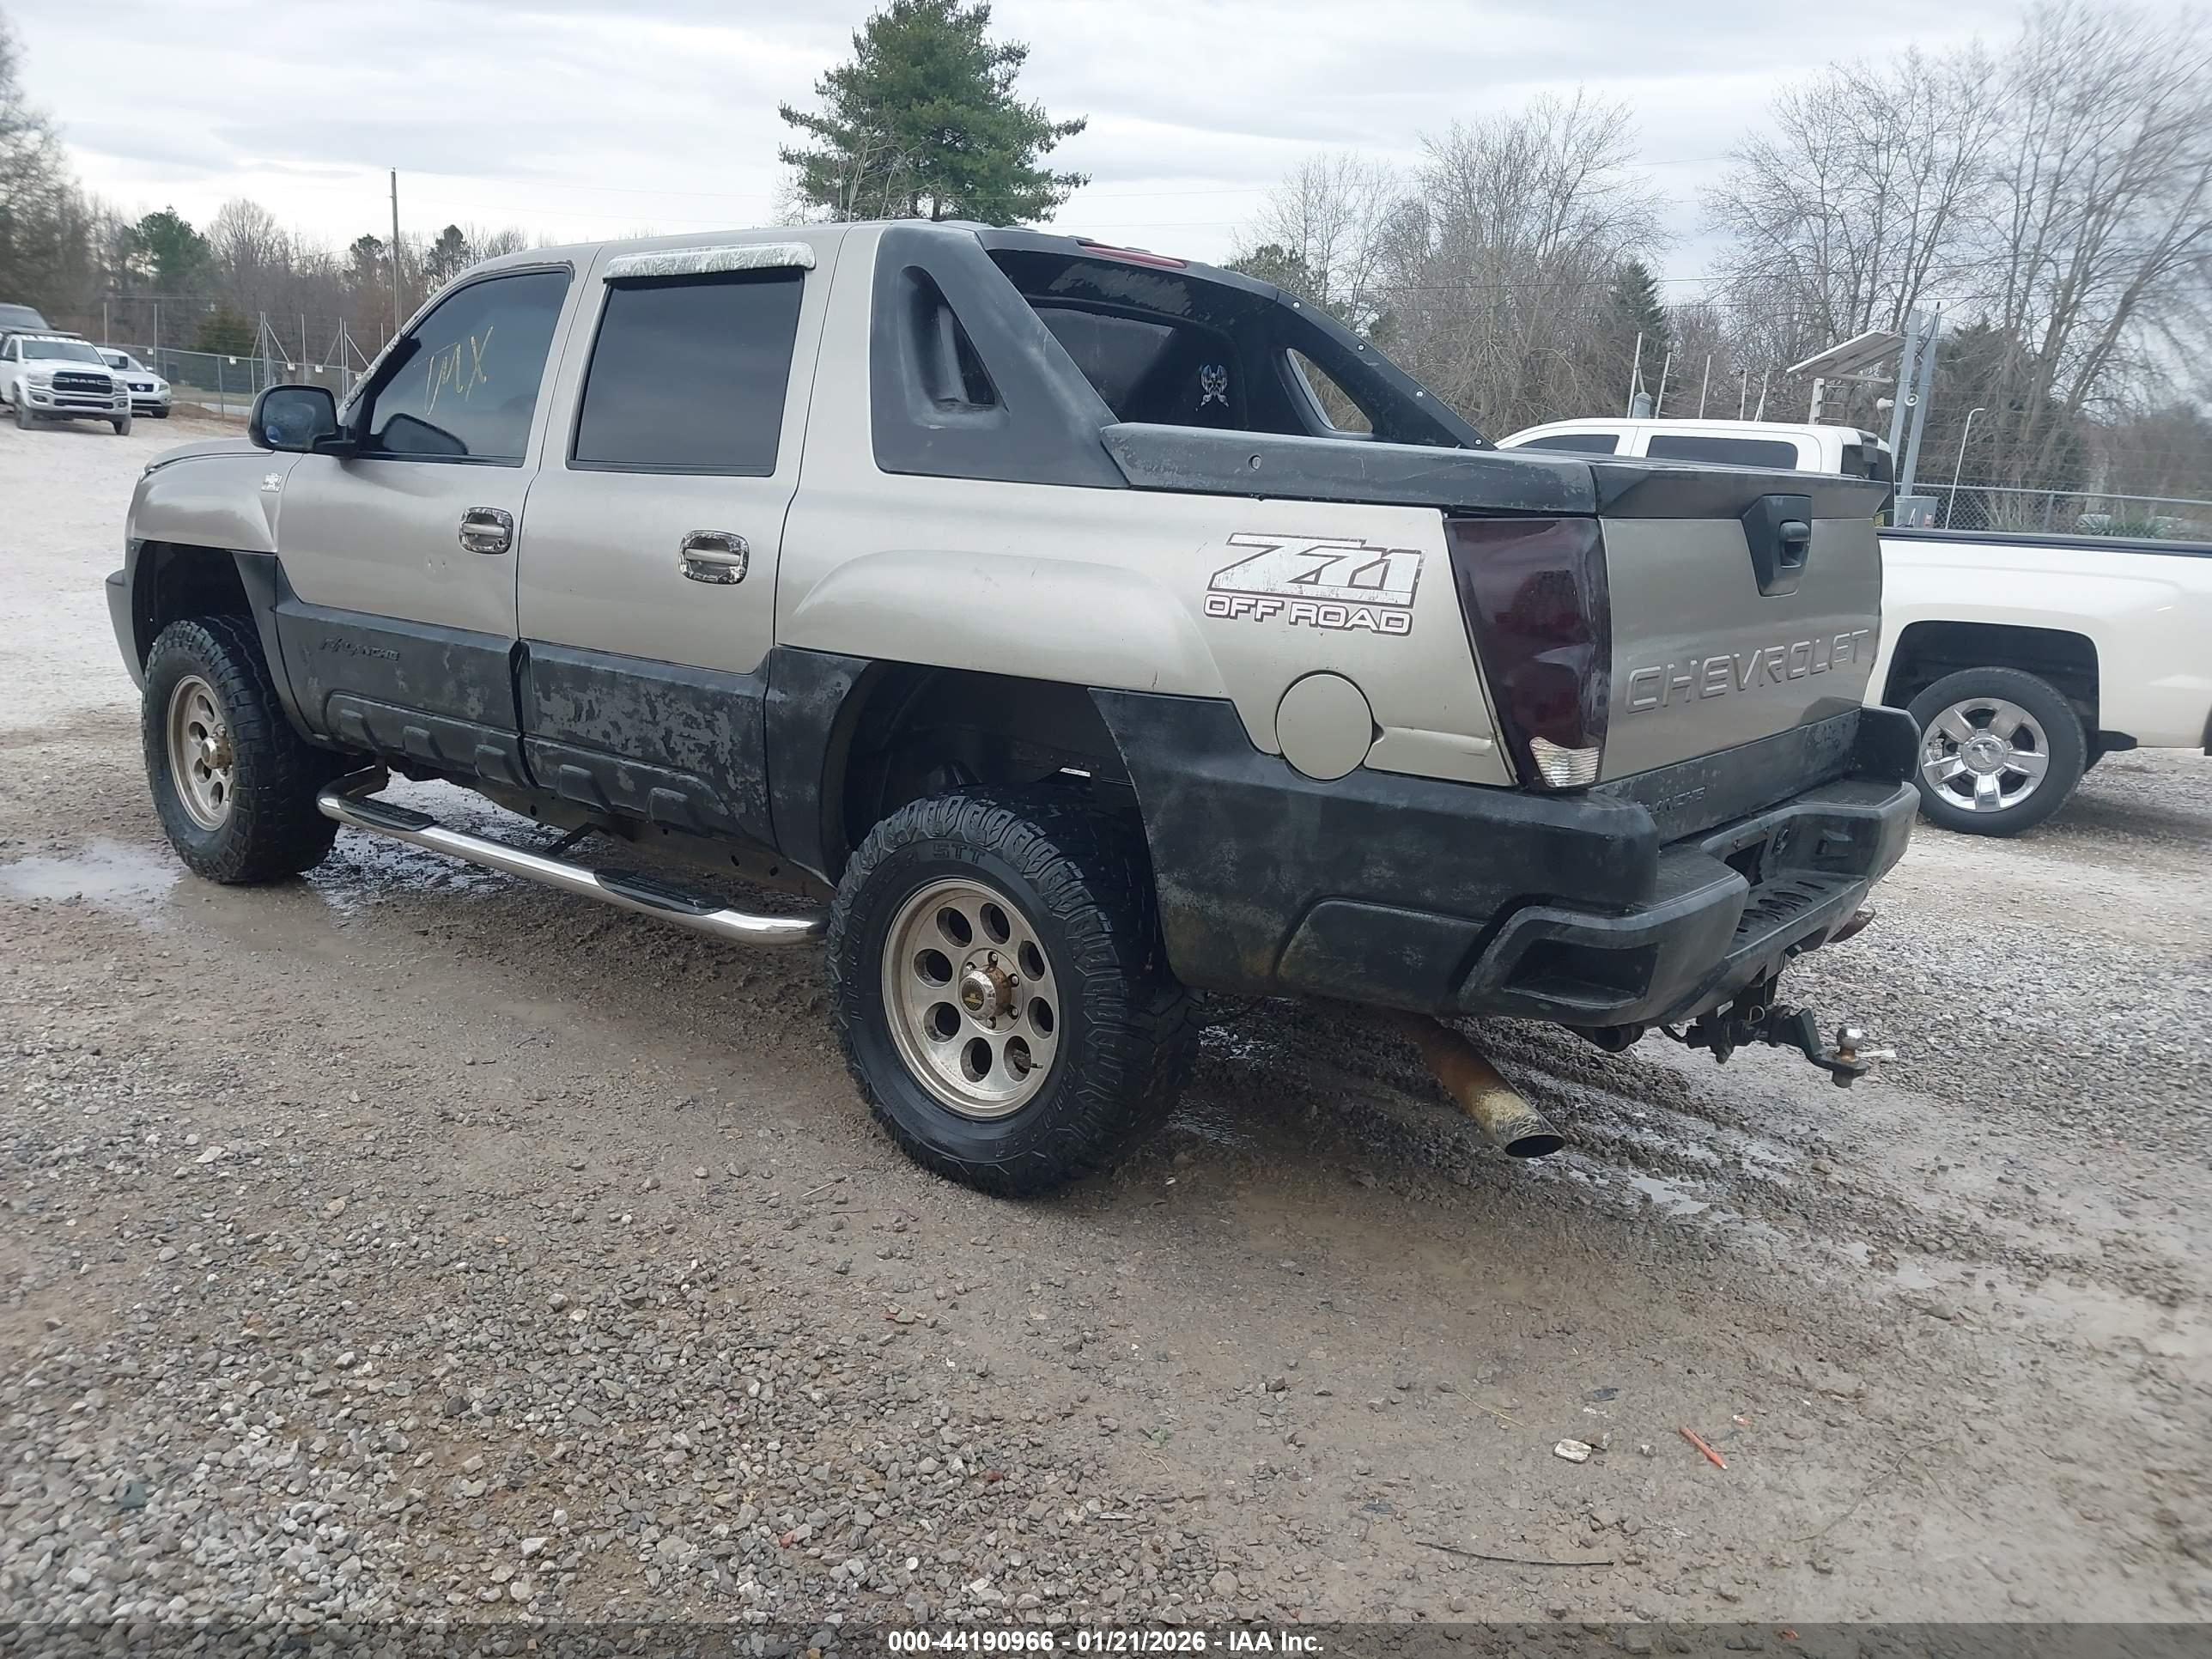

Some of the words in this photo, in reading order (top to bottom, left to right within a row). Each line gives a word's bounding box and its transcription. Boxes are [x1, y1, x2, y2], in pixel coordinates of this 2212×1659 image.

[1206, 532, 1427, 610] Z71
[1203, 594, 1285, 623] OFF
[1288, 601, 1414, 637] ROAD
[1626, 629, 1870, 714] CHEVROLET
